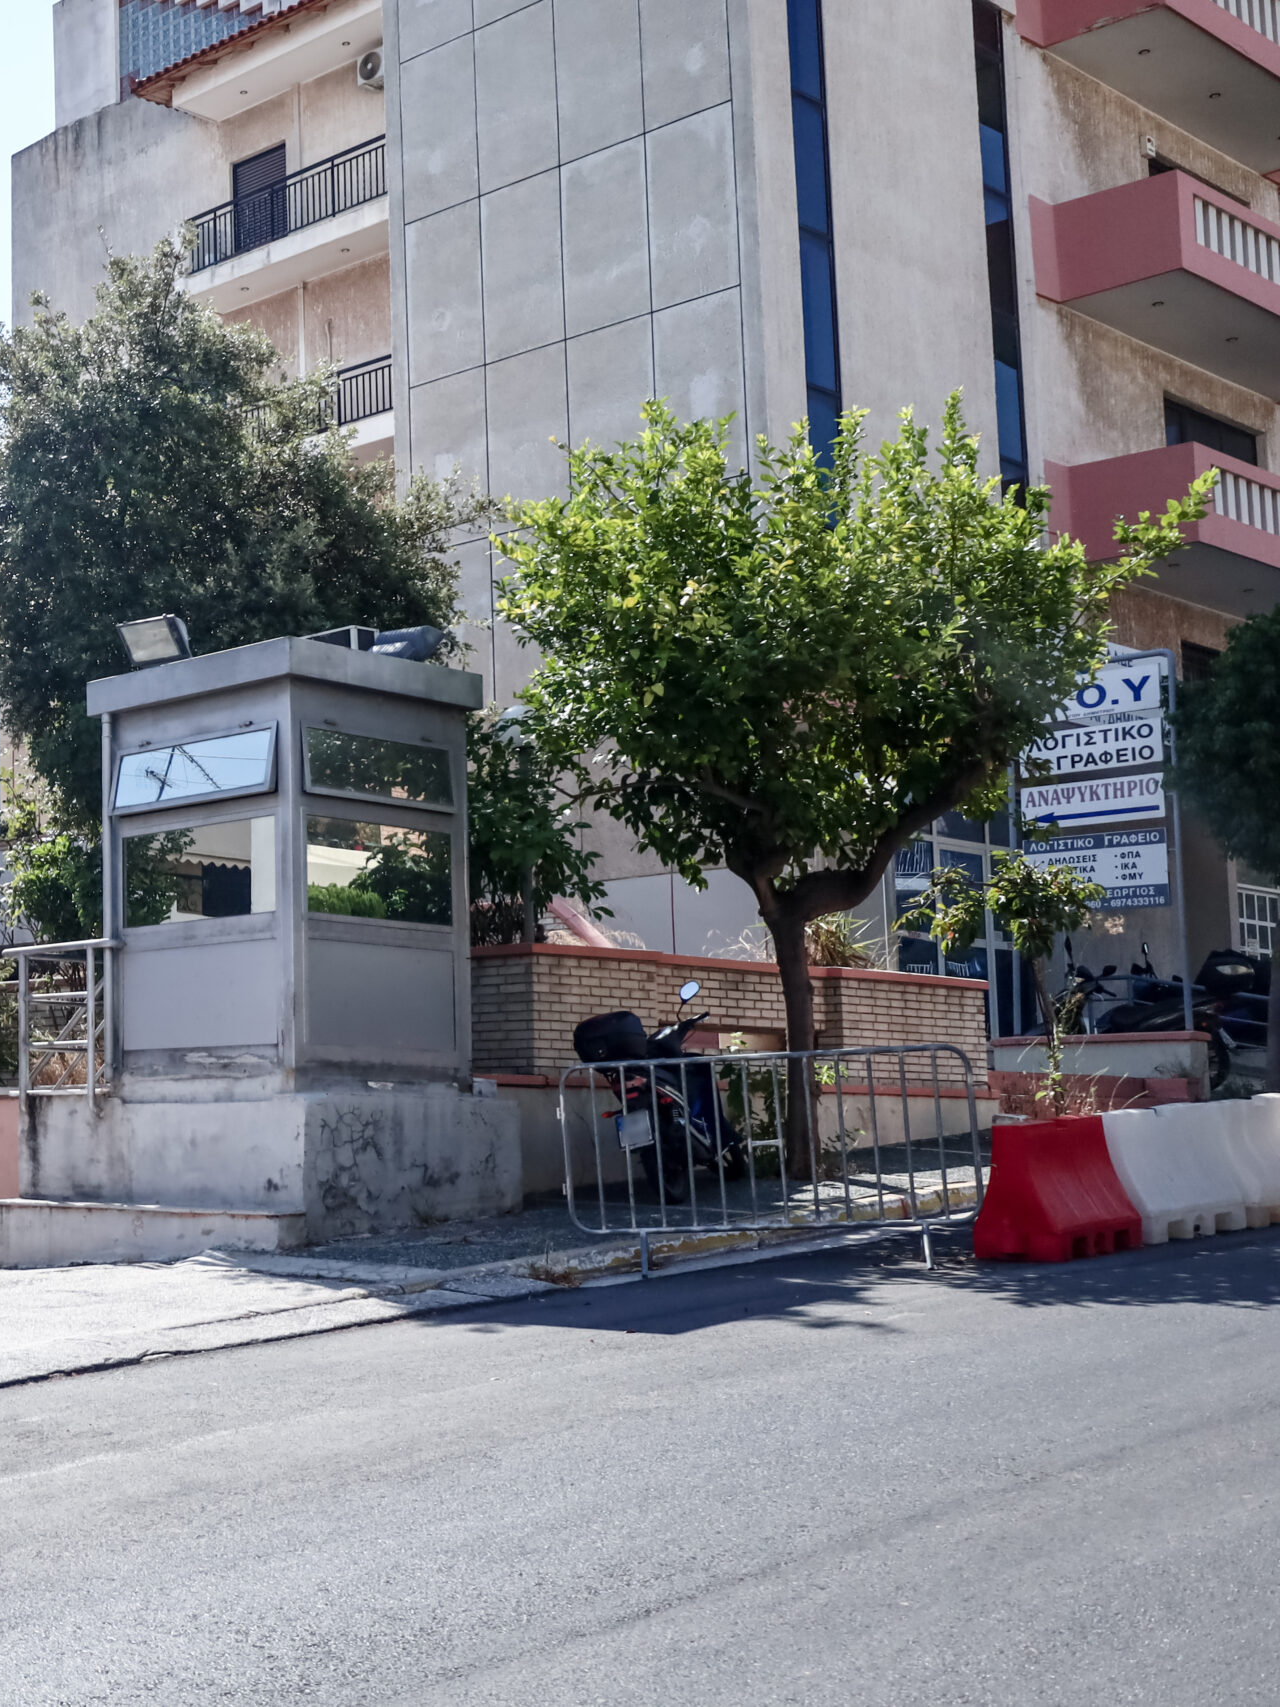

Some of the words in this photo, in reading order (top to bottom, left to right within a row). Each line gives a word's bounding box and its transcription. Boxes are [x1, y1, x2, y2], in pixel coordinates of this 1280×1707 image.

[1028, 723, 1154, 754] ΛΟΓΙΣΤΙΚΟ
[1056, 744, 1155, 770] ΓΡΑΦΕΙΟ
[1025, 777, 1160, 808] ΑΝΑΨΥΚΤΗΡΙΟ
[1029, 837, 1094, 853] ΛΟΓΙΣΤΙΚΟ
[1104, 831, 1160, 847] ΓΡΑΦΕΙΟ
[1047, 854, 1098, 866] ΔΗΛΩΣΕΙΣ
[1119, 850, 1141, 860] ΦΠΑ
[1120, 863, 1138, 871] ΙΚΑ
[1120, 872, 1144, 881] ΦΜΥ
[1110, 896, 1166, 907] 6974333116
